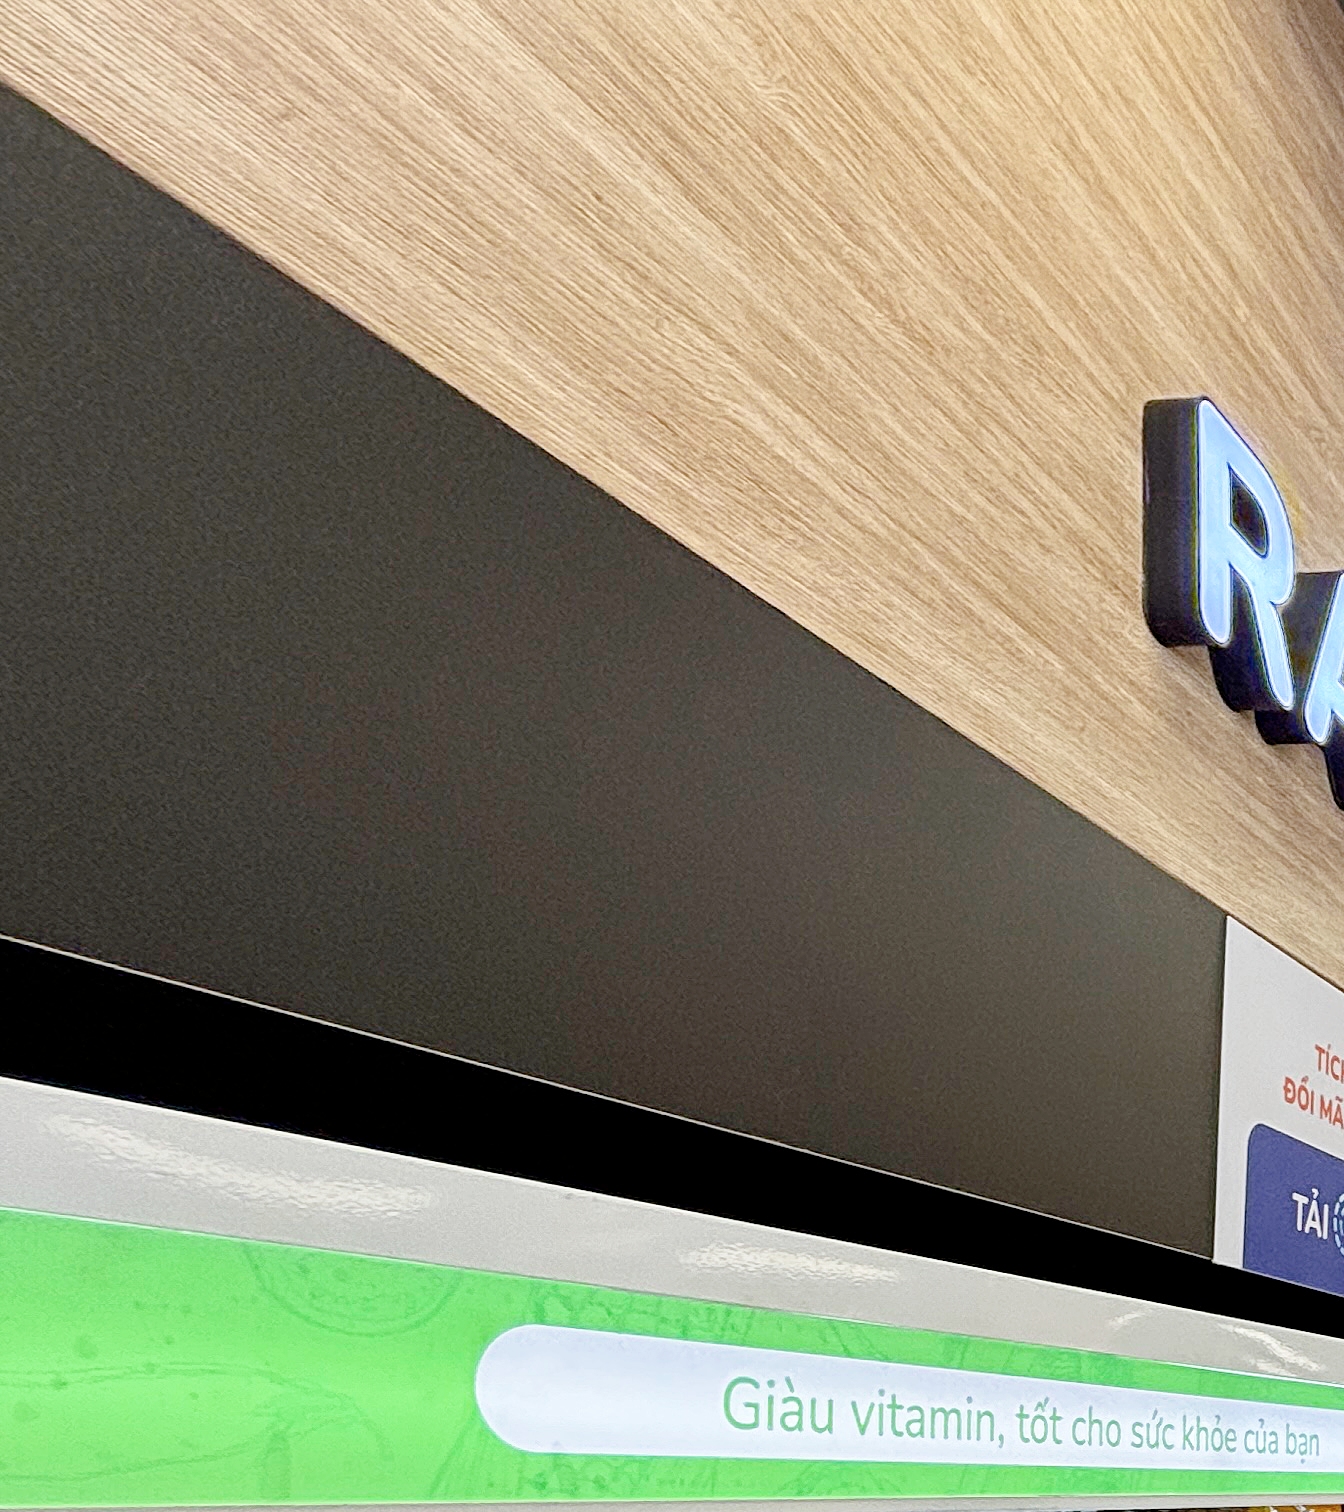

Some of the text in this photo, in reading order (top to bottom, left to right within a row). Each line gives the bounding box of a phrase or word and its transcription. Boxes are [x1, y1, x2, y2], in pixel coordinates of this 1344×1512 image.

[1283, 1075, 1315, 1116] ĐỔI
[1319, 1095, 1344, 1130] MÃ
[1291, 1188, 1330, 1241] TẢI
[723, 1375, 1321, 1465] Giàu vitamin, tốt cho sức khỏe của bạn
